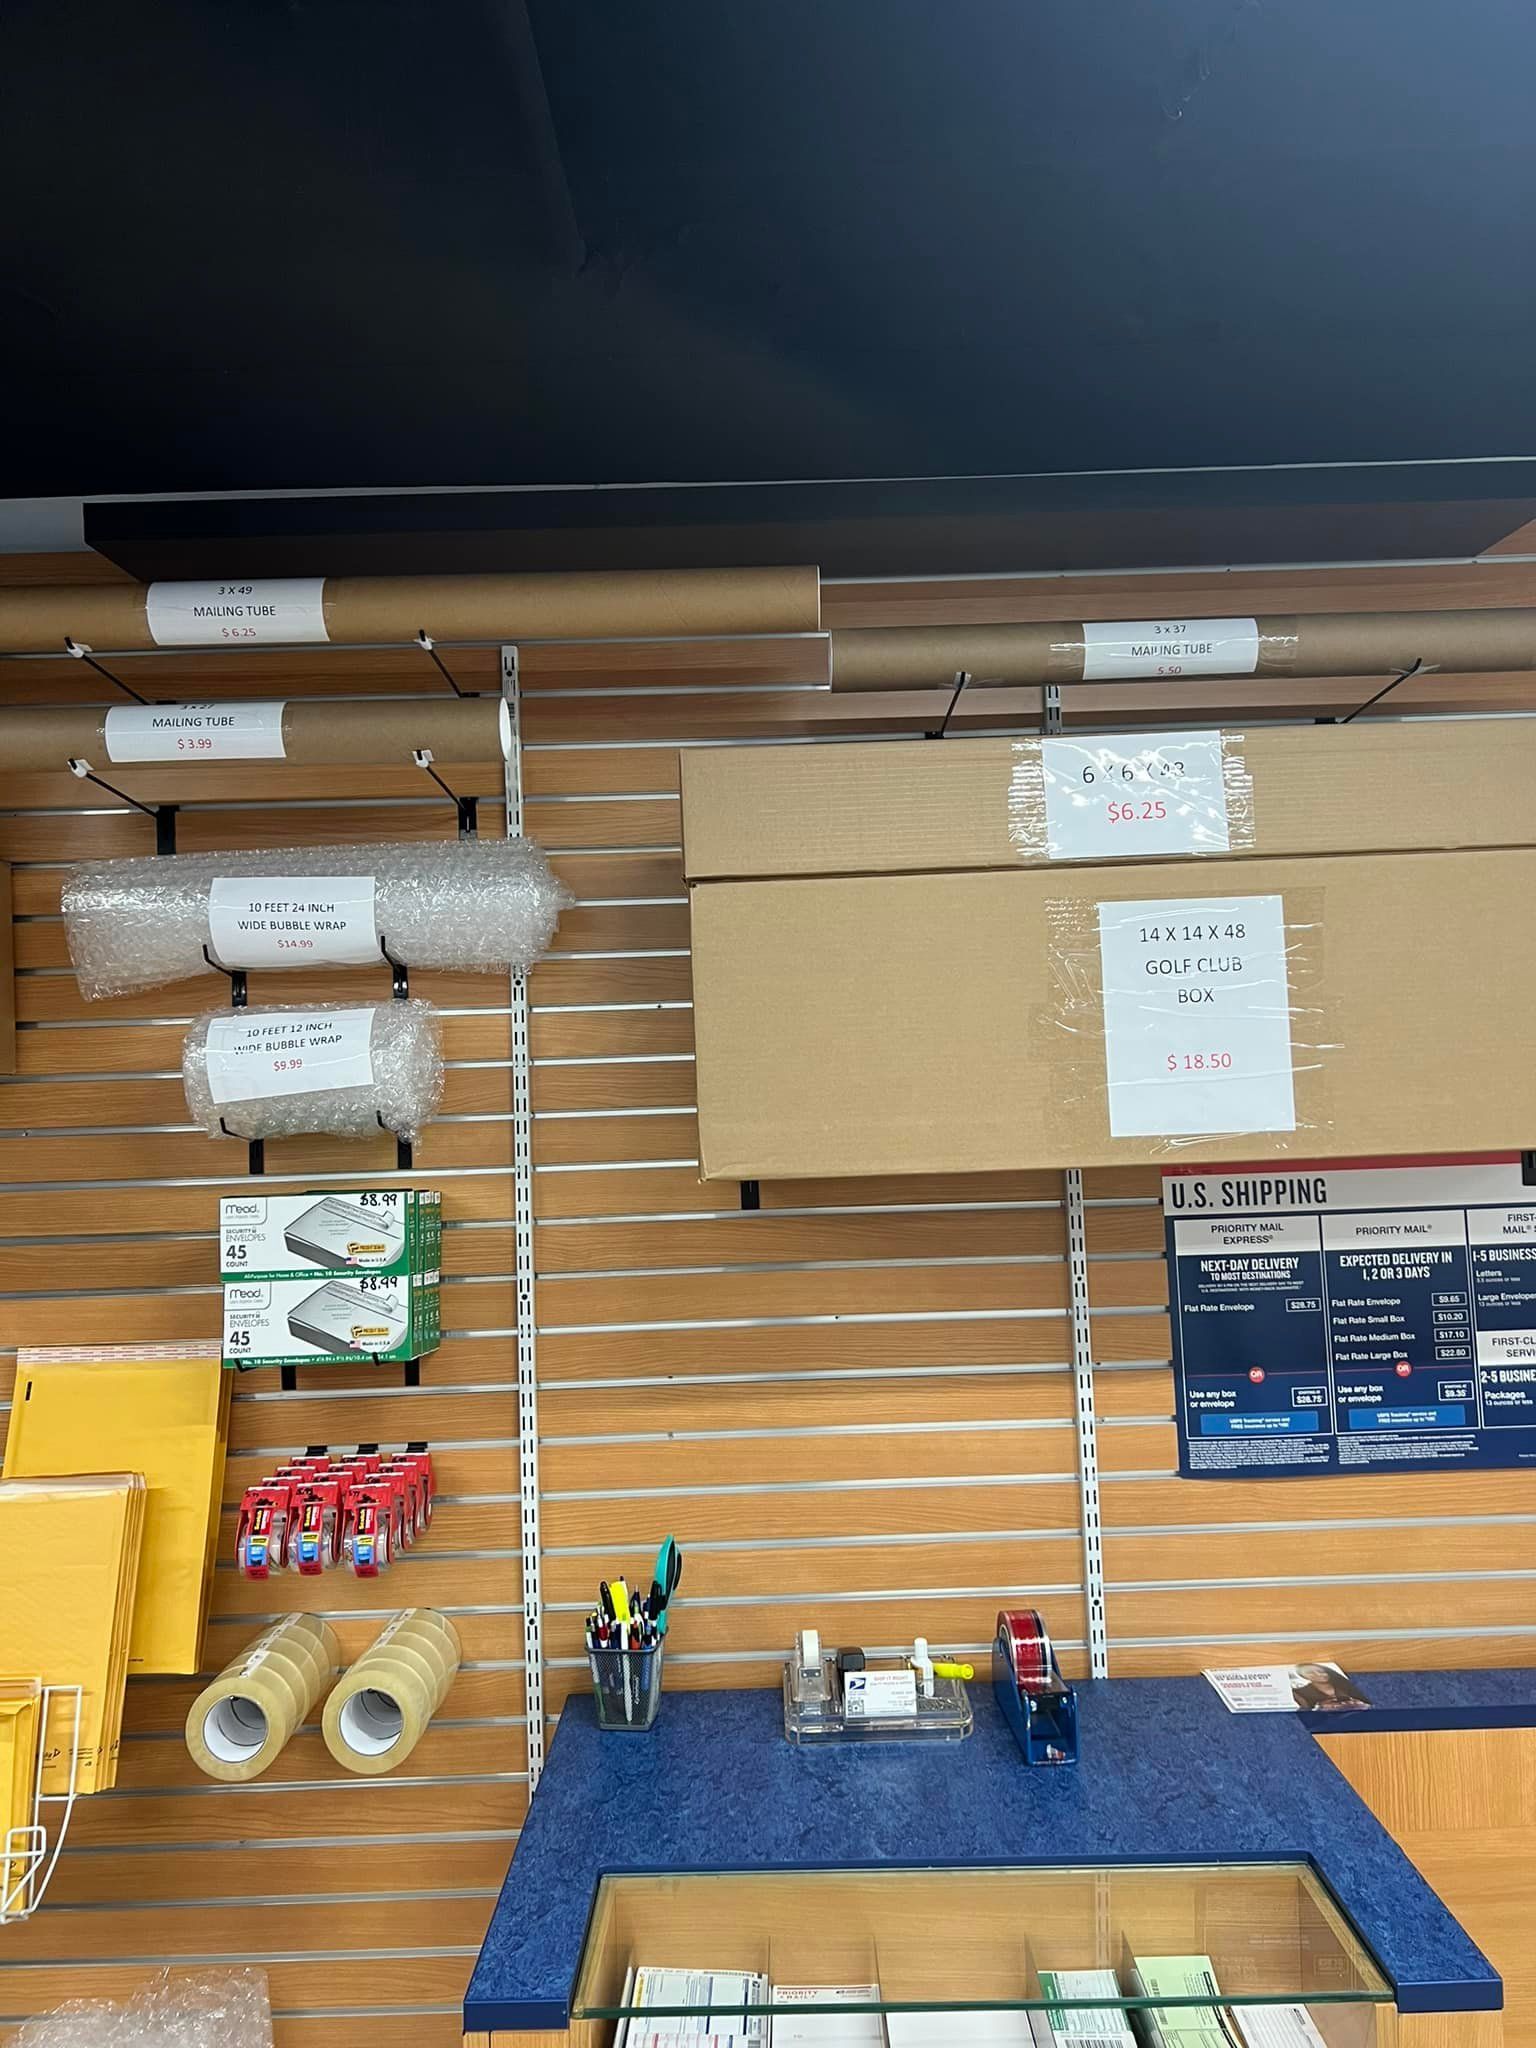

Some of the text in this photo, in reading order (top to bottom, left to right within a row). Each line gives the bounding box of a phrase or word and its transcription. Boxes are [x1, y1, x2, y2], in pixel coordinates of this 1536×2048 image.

[217, 587, 225, 595] 3
[238, 586, 253, 595] 49
[193, 605, 276, 617] MAILING TUBE
[221, 627, 256, 638] $ 6.25
[1154, 626, 1162, 634] 3
[1173, 625, 1186, 633] 37
[1131, 643, 1213, 656] MAILING TUBE
[152, 716, 235, 728] MAILING TUBE
[177, 738, 212, 750] $ 3.99
[1083, 766, 1095, 784] 6
[1102, 765, 1114, 780] X
[1122, 764, 1134, 781] 6
[1107, 801, 1167, 824] $6.25
[248, 903, 335, 913] 10 FEET 24 INCH
[238, 920, 347, 931] WIDE BUBBLE WRAP
[1140, 923, 1246, 943] 14 X 14 X 48
[277, 939, 313, 949] $14.99
[1145, 957, 1242, 975] GOLF CLUB
[1177, 987, 1215, 1004] BOX
[247, 1022, 333, 1038] 10 FEET 12 INCH
[265, 1039, 306, 1052] BUBBLE
[309, 1035, 343, 1046] WRAP
[273, 1059, 303, 1072] $9.99
[1167, 1052, 1232, 1072] $ 18.50
[1172, 1178, 1327, 1209] U.S. SHIPPING
[360, 1193, 397, 1206] $8.99
[1211, 1223, 1284, 1233] PRIORITY MAIL
[1356, 1226, 1401, 1235] PRIORITY
[226, 1233, 266, 1242] ENVELOPES
[226, 1245, 247, 1259] 45
[1488, 1248, 1536, 1261] BUSINESS
[1201, 1257, 1299, 1272] NEXT-DAY DELIVERY
[1340, 1251, 1452, 1267] EXPECTED DELIVERY IN
[1210, 1271, 1291, 1281] TO MOST DESTINATIONS
[1371, 1268, 1379, 1280] 2
[1380, 1267, 1395, 1280] OR
[1396, 1267, 1403, 1279] 3
[1405, 1266, 1430, 1279] DAYS
[360, 1276, 398, 1292] $8.99
[1332, 1299, 1346, 1307] Flat
[1366, 1298, 1400, 1306] Envelope
[1478, 1293, 1499, 1302] Large
[1184, 1303, 1254, 1312] Flat Rate Envelope
[1333, 1317, 1347, 1325] Flat
[1367, 1316, 1389, 1324] Small
[1438, 1313, 1463, 1321] $10.20
[229, 1319, 270, 1328] ENVELOPES
[229, 1331, 250, 1346] 45
[1334, 1332, 1415, 1343] Flat Rate Medium Box
[1439, 1331, 1465, 1339] $17.10
[1336, 1353, 1350, 1361] Flat
[1351, 1352, 1368, 1360] Rate
[1370, 1351, 1391, 1360] Large
[1396, 1364, 1409, 1372] OR
[1250, 1370, 1263, 1378] OR
[1480, 1371, 1498, 1383] 2-5
[1190, 1390, 1236, 1399] Use any box
[1354, 1386, 1367, 1394] any
[1484, 1391, 1526, 1400] Packages
[1200, 1400, 1235, 1408] envelope
[1347, 1395, 1382, 1403] envelope
